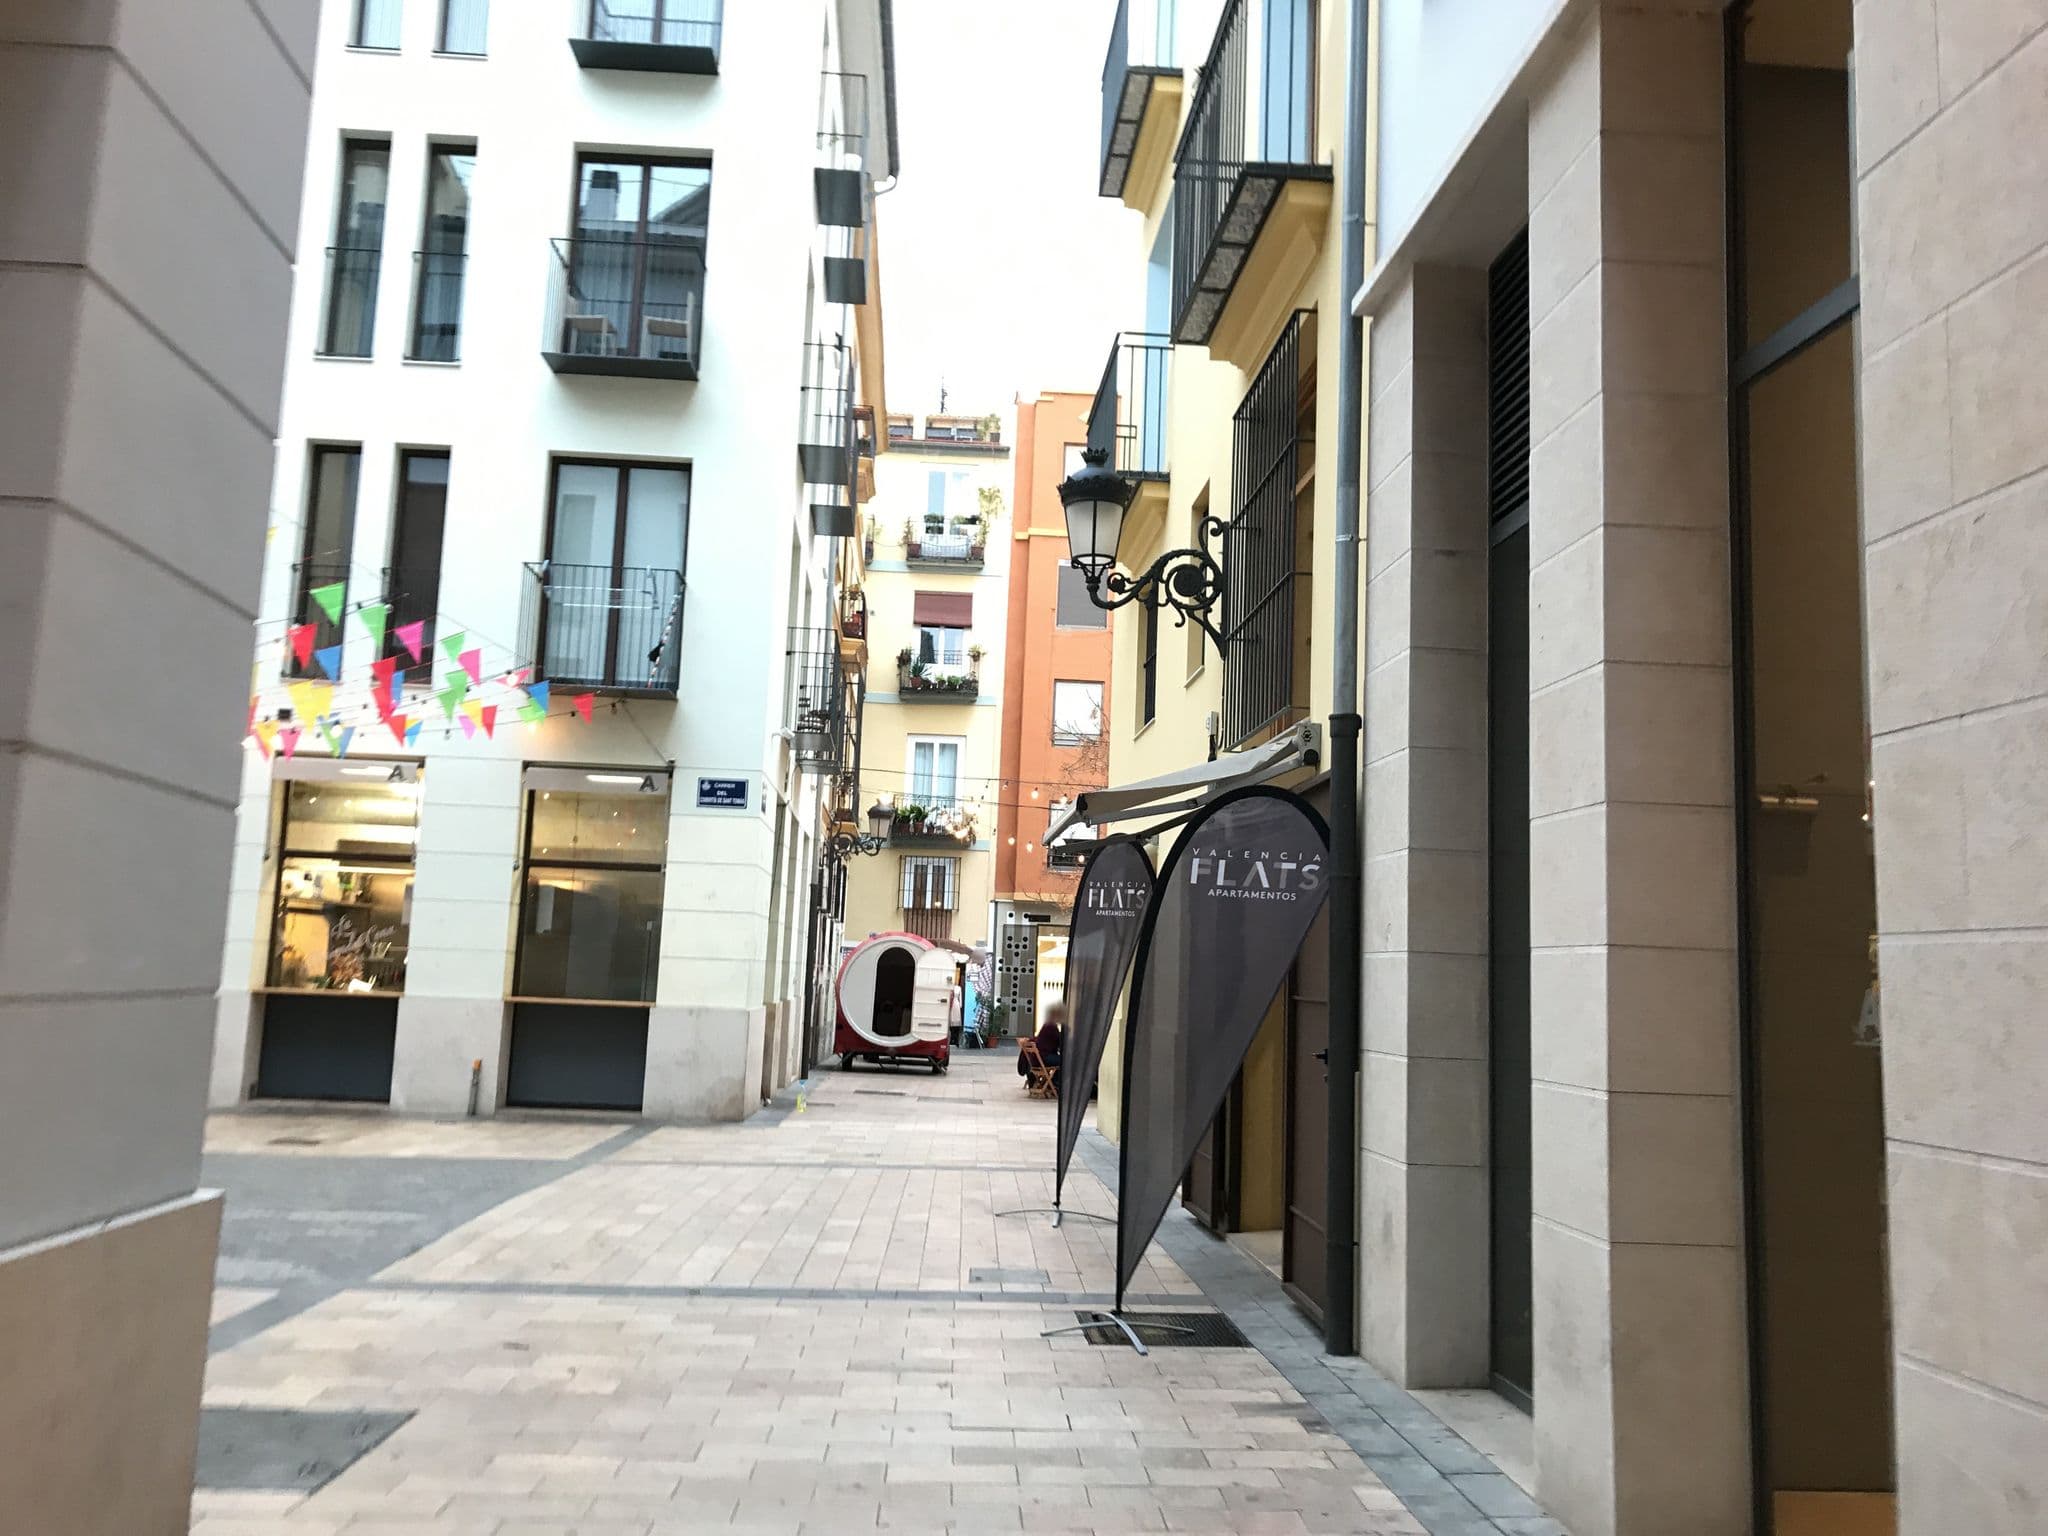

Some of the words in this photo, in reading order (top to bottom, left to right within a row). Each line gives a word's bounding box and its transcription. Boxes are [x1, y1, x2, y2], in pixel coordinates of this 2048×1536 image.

[1192, 847, 1322, 862] VALENCIA
[1190, 857, 1321, 891] FLATS
[1089, 880, 1147, 888] VALENCIA
[1088, 888, 1146, 909] FLATS
[1208, 888, 1297, 901] APARTAMENTOS
[1095, 909, 1136, 918] APARTAMENTOS
